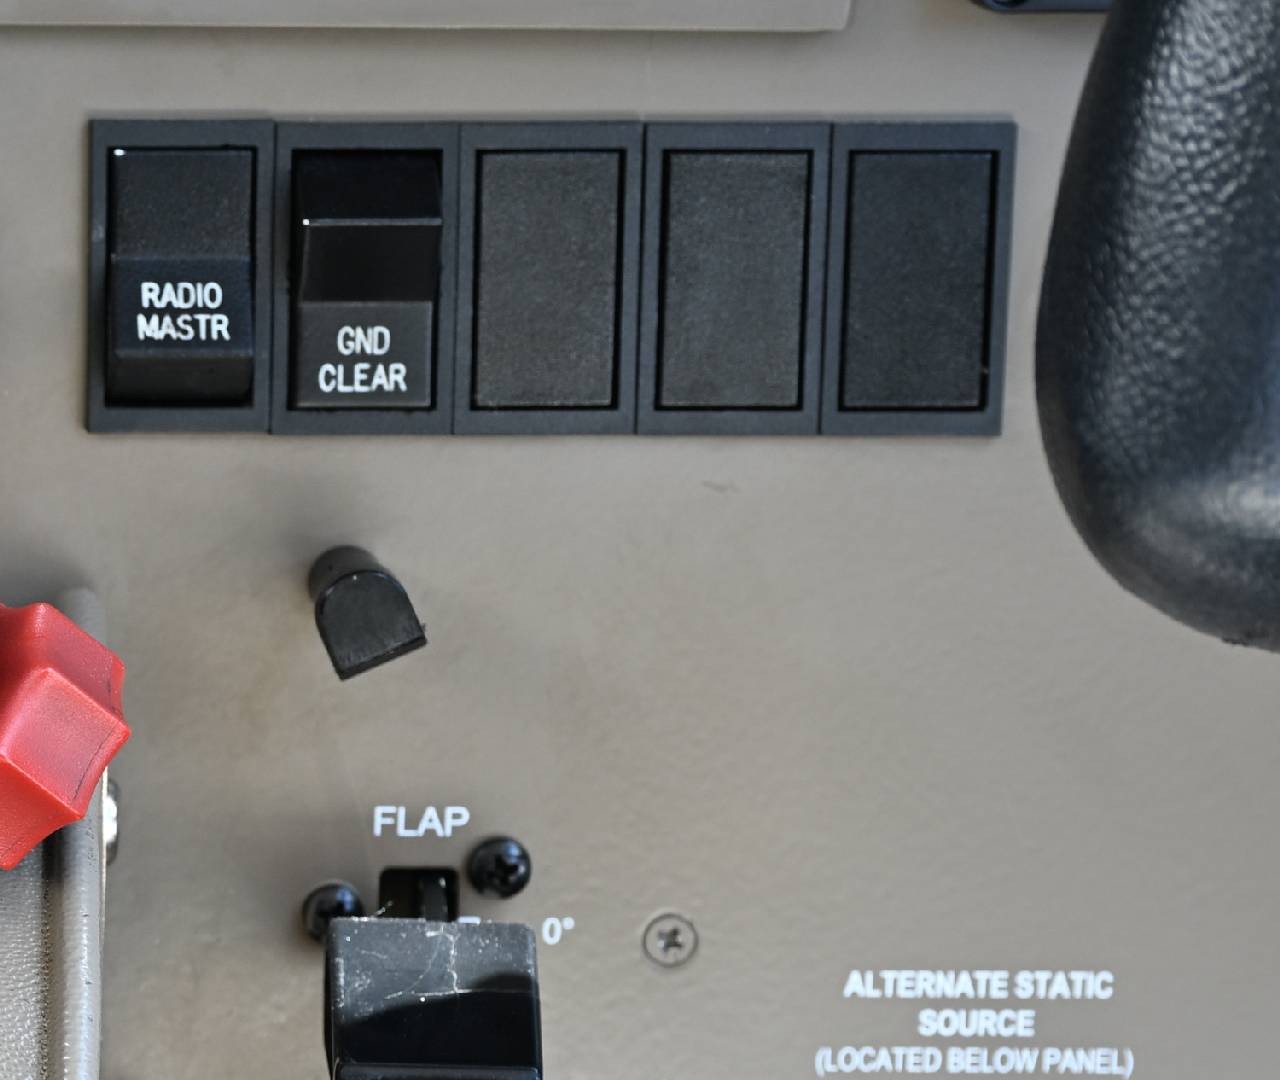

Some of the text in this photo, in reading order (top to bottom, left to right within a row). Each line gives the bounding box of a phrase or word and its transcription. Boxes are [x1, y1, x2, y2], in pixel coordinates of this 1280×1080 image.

[141, 282, 222, 309] RADIO
[136, 313, 230, 341] MASTR
[338, 326, 390, 356] GND
[318, 363, 407, 393] CLEAR
[373, 807, 471, 836] FLAP
[542, 917, 574, 944] 0°
[843, 970, 1113, 1000] ALTERNATE STATIC
[918, 1009, 1036, 1037] SOURCE
[815, 1047, 1134, 1080] (LOCATED BELOW PANEL)
